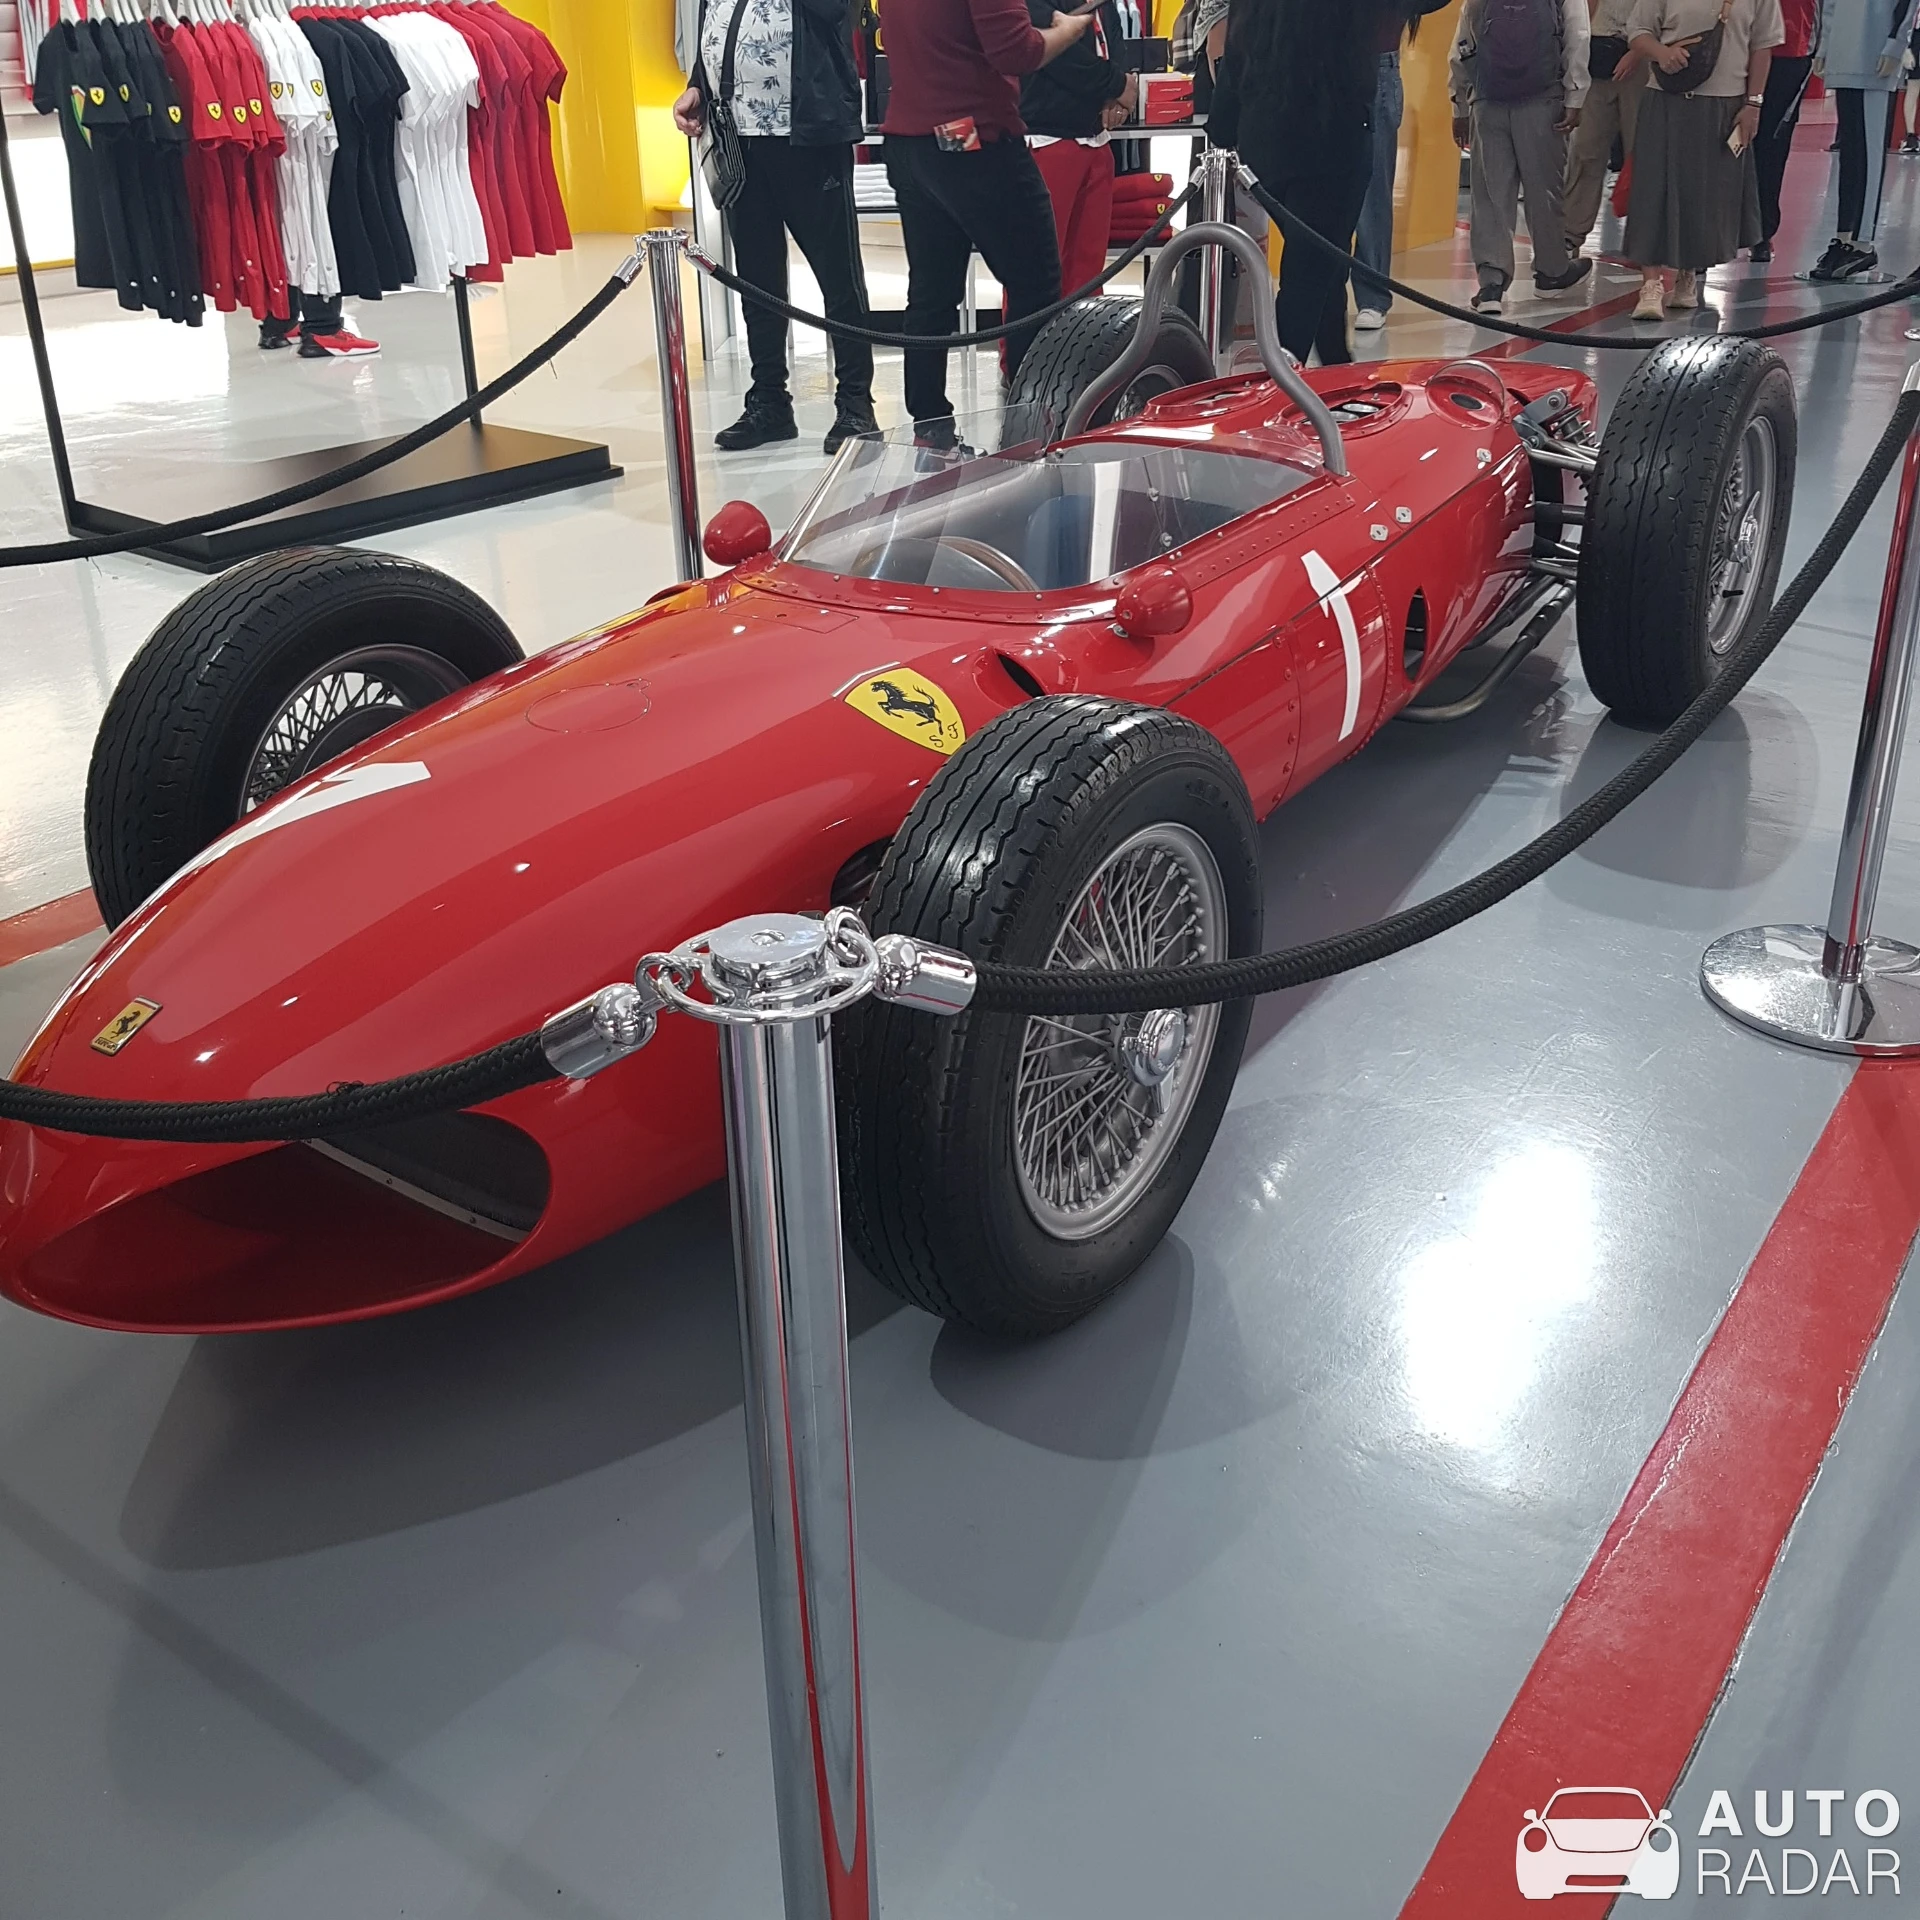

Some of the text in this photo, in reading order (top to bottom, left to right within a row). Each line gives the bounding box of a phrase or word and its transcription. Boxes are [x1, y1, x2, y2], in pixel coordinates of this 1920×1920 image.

[1301, 550, 1362, 742] 1
[929, 721, 958, 748] S F
